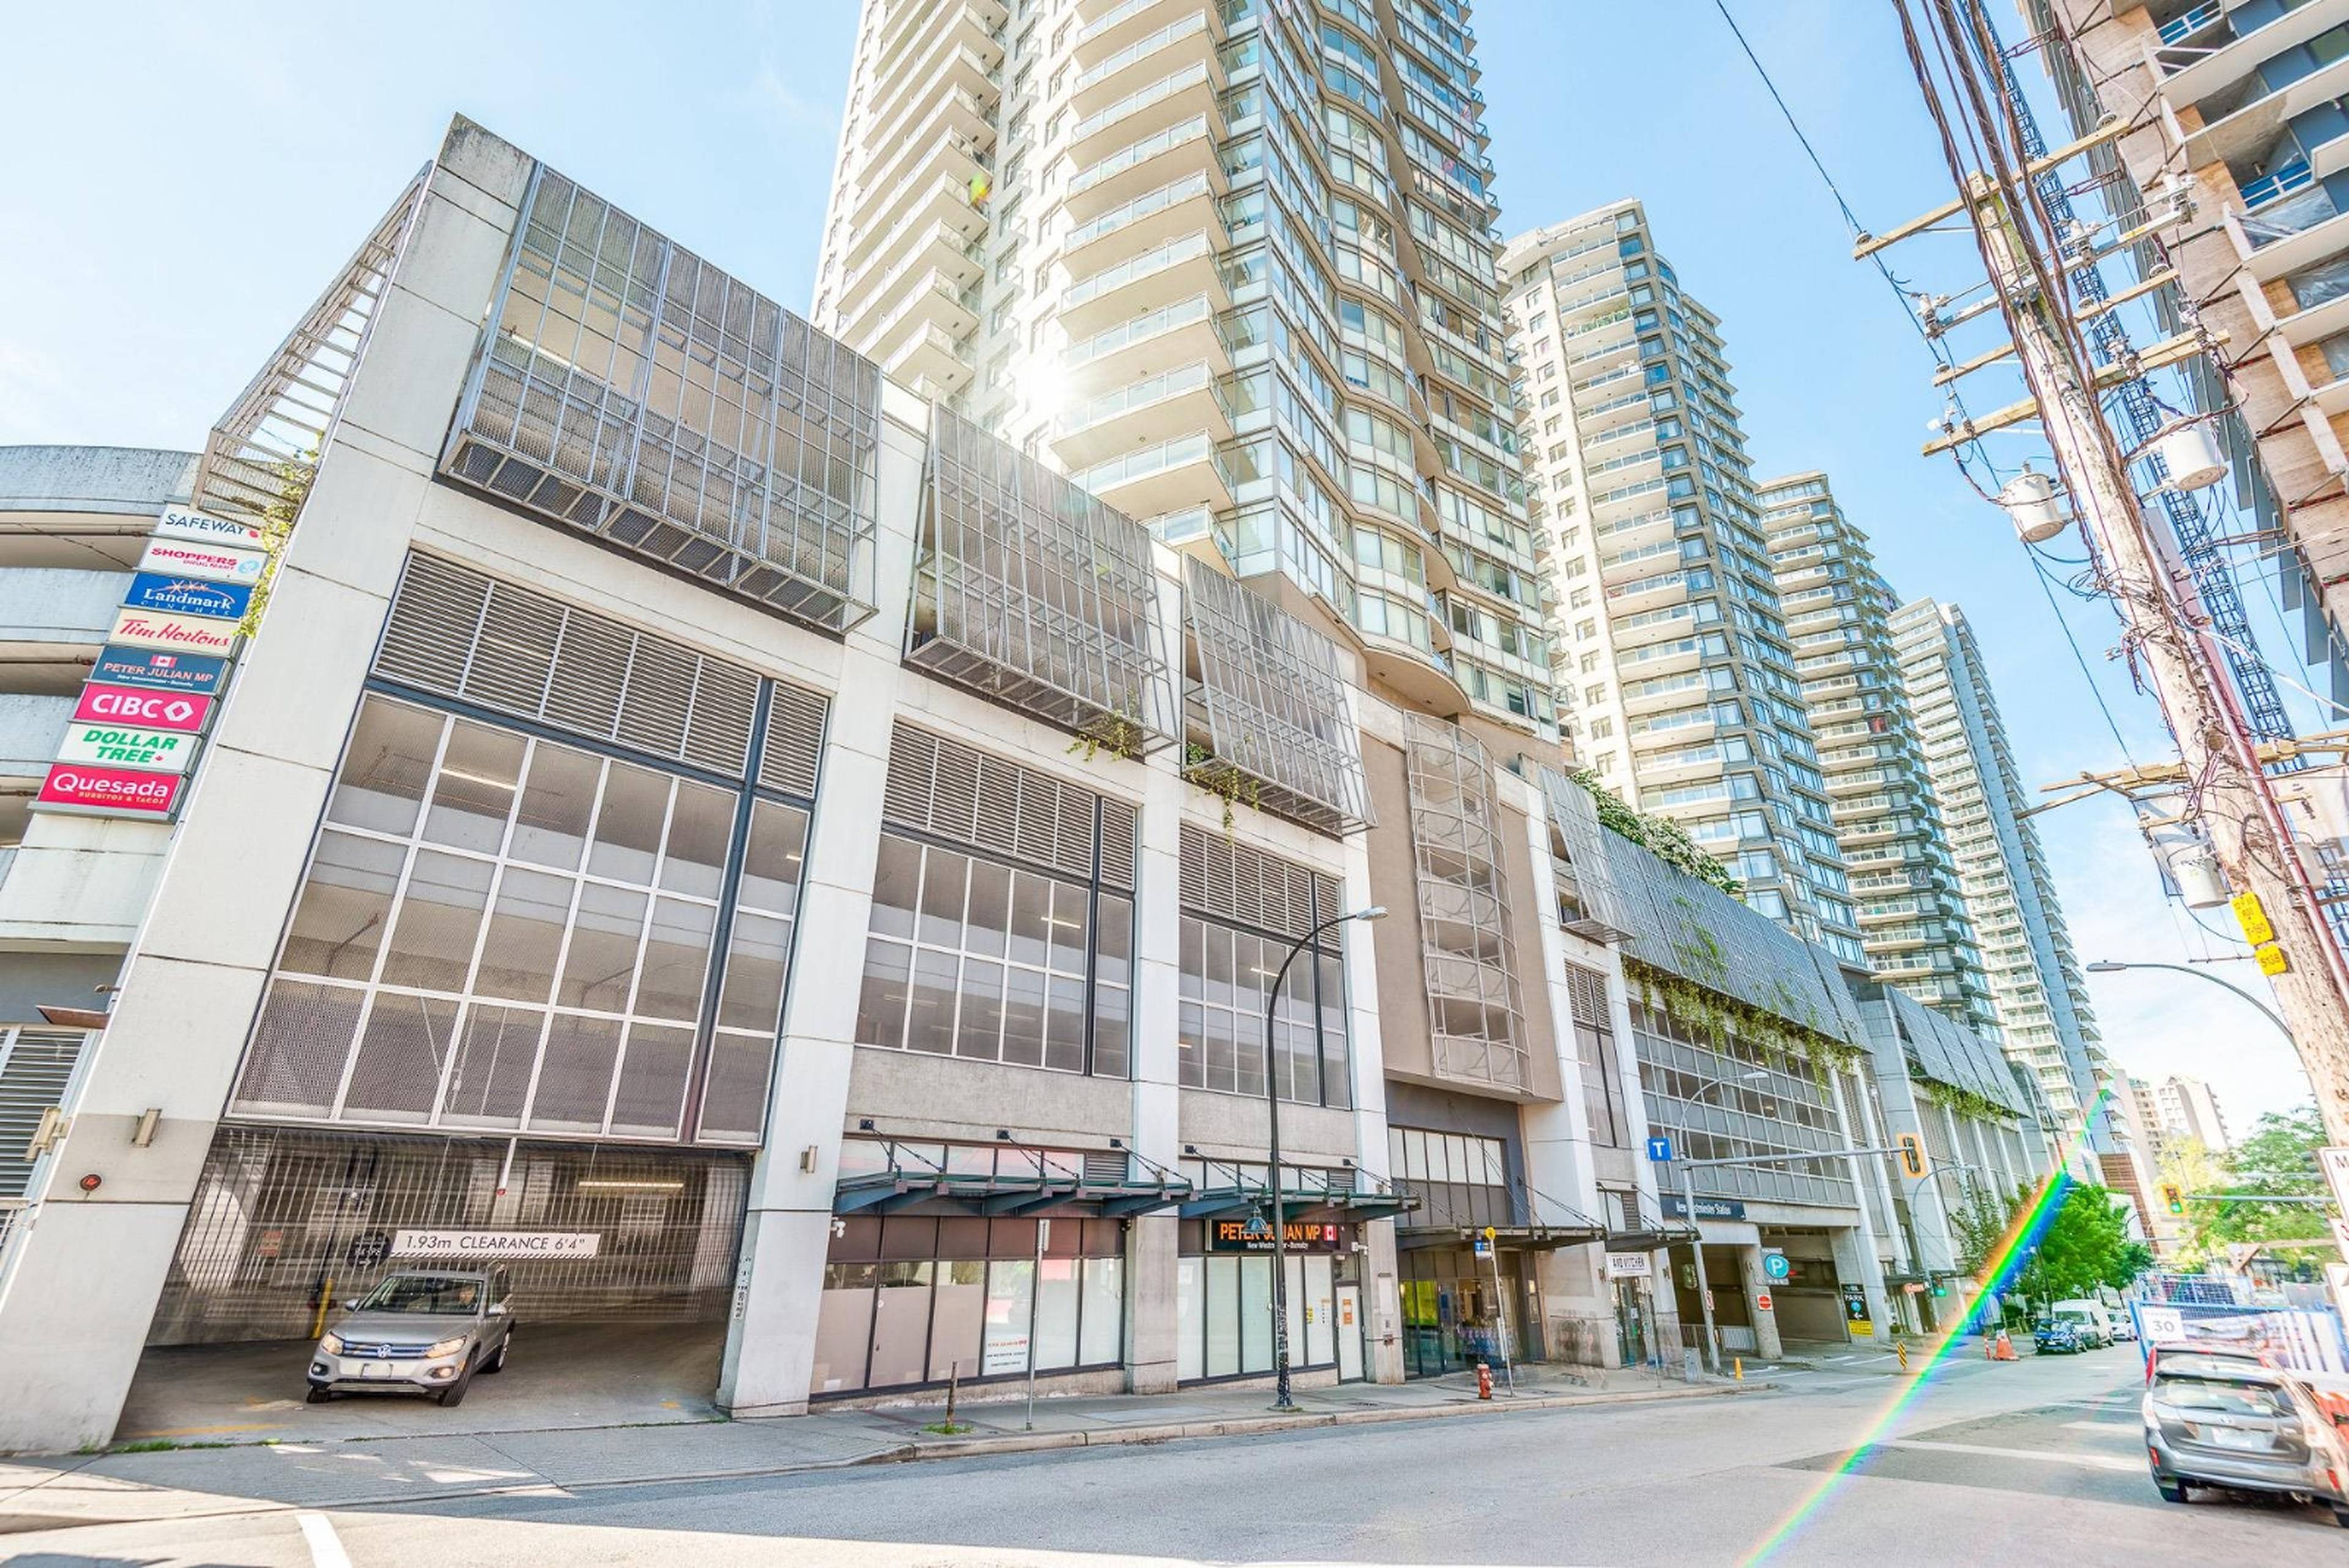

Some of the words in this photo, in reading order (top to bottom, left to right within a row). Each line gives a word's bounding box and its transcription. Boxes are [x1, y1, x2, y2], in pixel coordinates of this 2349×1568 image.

[166, 513, 245, 535] SAFEWAY
[150, 547, 237, 567] SHOPPERS
[143, 589, 232, 609] Landmark
[119, 619, 155, 637] Tim
[157, 623, 229, 647] Hortons
[103, 663, 146, 675] PETER
[147, 668, 192, 681] JULIAN
[193, 673, 213, 682] MP
[92, 694, 163, 718] CIBC
[83, 729, 179, 751] DOLLAR
[97, 746, 156, 763] TREE
[53, 773, 168, 797] Quesada
[1653, 1142, 1664, 1157] T
[1262, 1224, 1302, 1241] JUIAN
[1305, 1225, 1321, 1241] MP
[406, 1235, 451, 1249] 1.93m
[460, 1236, 549, 1250] CLEARANCE
[555, 1238, 585, 1250] 6'4"
[1772, 1258, 1783, 1275] P
[2153, 1320, 2175, 1332] 30
